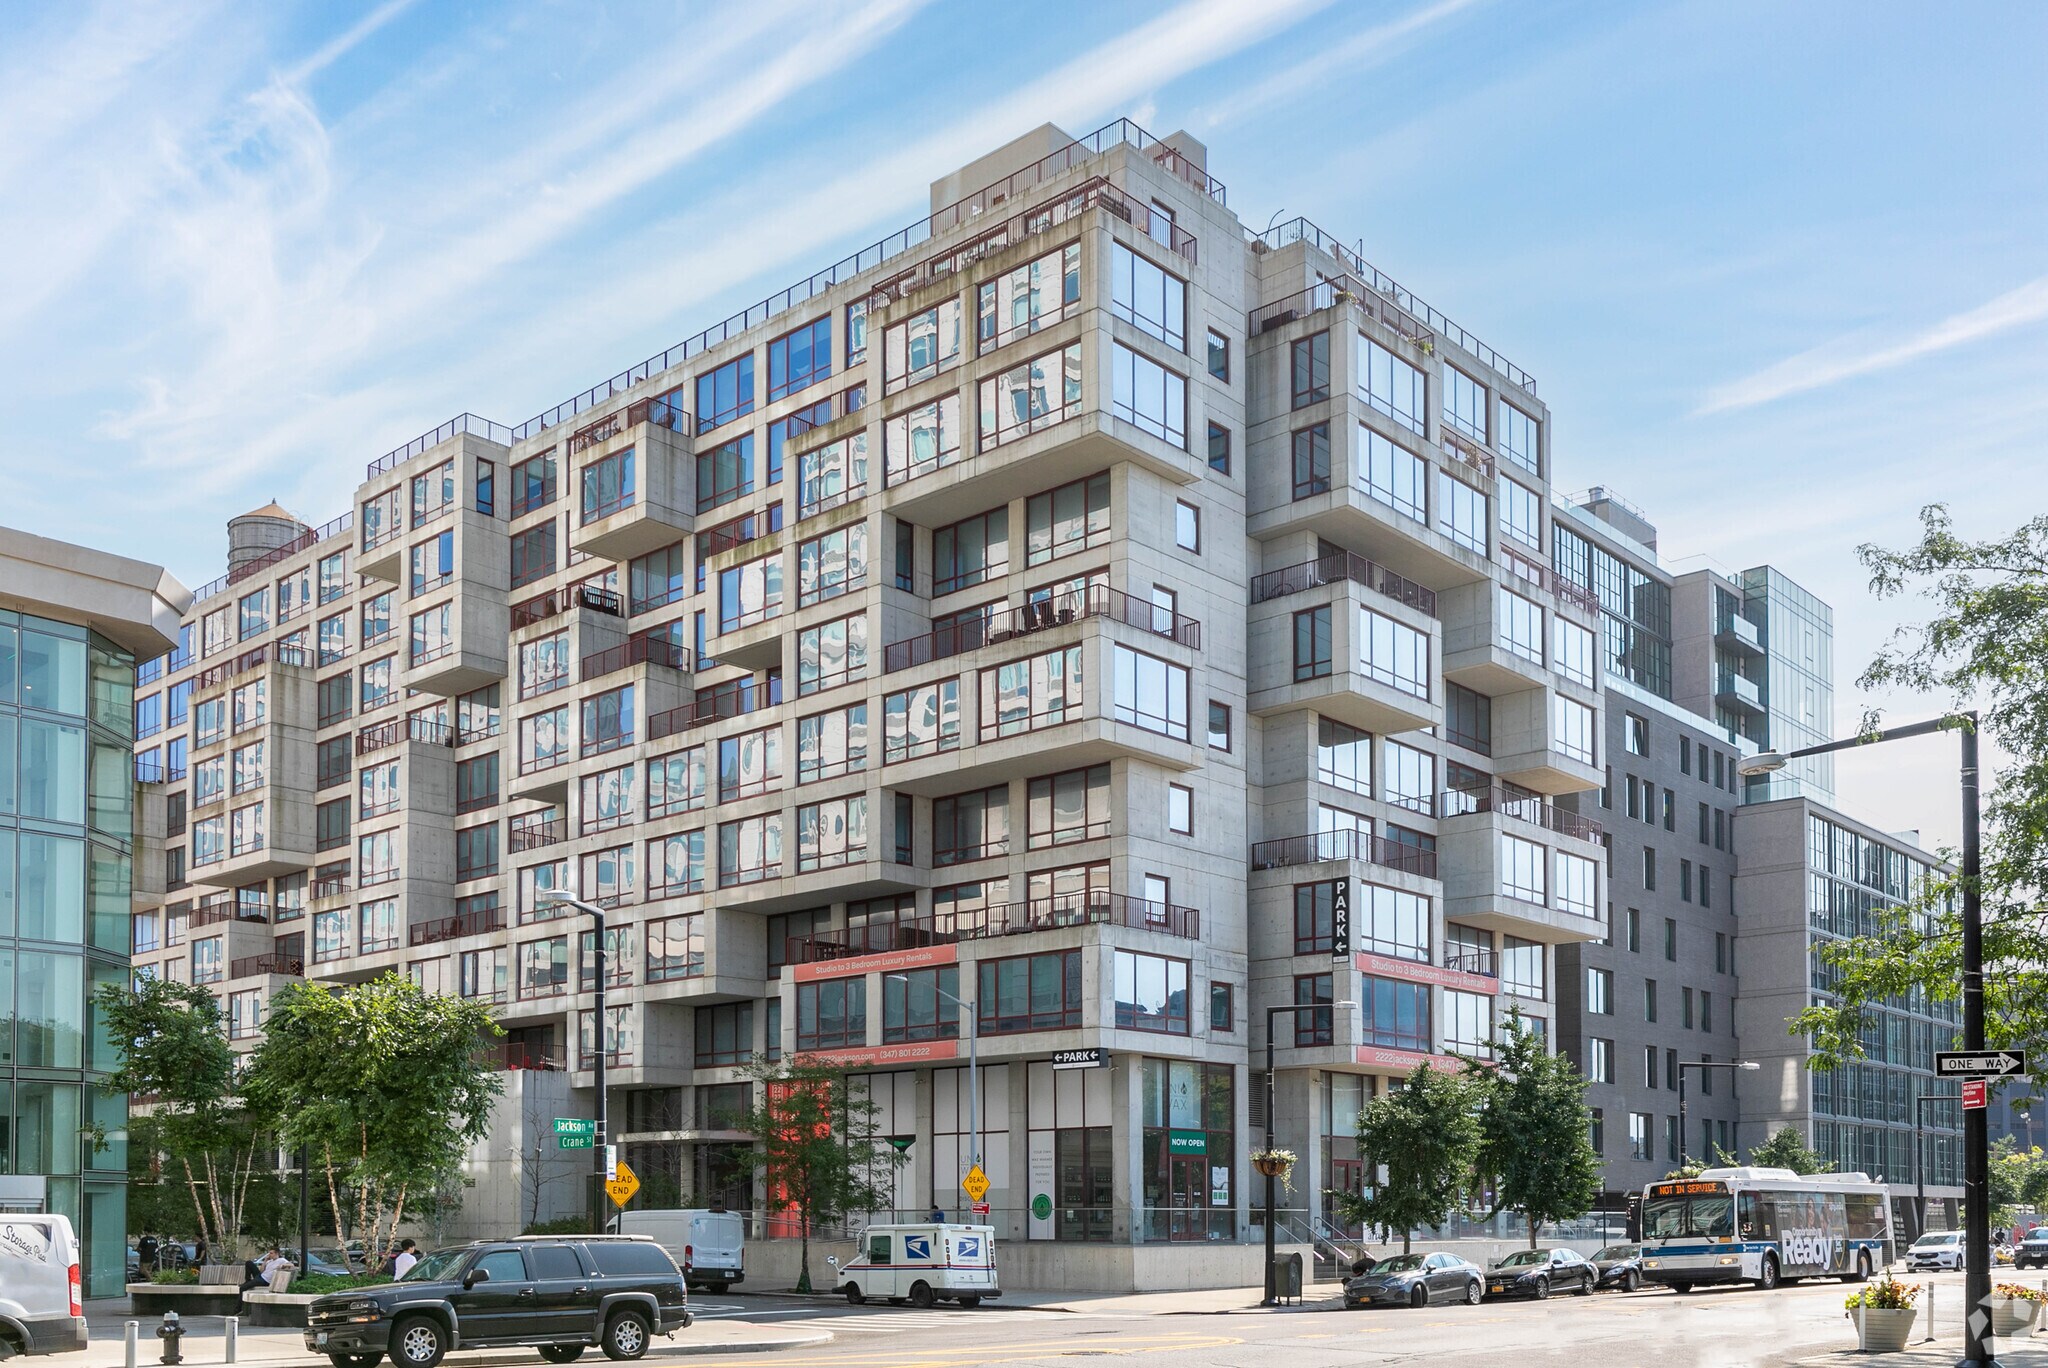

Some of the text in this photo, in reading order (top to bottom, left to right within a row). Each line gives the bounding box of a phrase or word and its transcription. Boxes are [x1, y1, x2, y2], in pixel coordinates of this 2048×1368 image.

[1335, 881, 1346, 937] PARK
[815, 953, 933, 975] Studio to 3 Bedroom Luxury Rentals
[1371, 960, 1486, 989] Studio to 3 Bedroom Luxury Rentals
[879, 1050, 898, 1060] (347)
[898, 1049, 911, 1058] 801
[911, 1047, 930, 1056] 2222
[1063, 1051, 1089, 1062] PARK
[1949, 1059, 2011, 1069] ONE WAY
[557, 1121, 586, 1132] Jackson
[562, 1137, 584, 1147] Crane
[1172, 1138, 1205, 1147] NOW OPEN
[612, 1186, 629, 1195] END
[1659, 1182, 1717, 1195] NOT IN SERVICE
[1781, 1229, 1832, 1270] Ready
